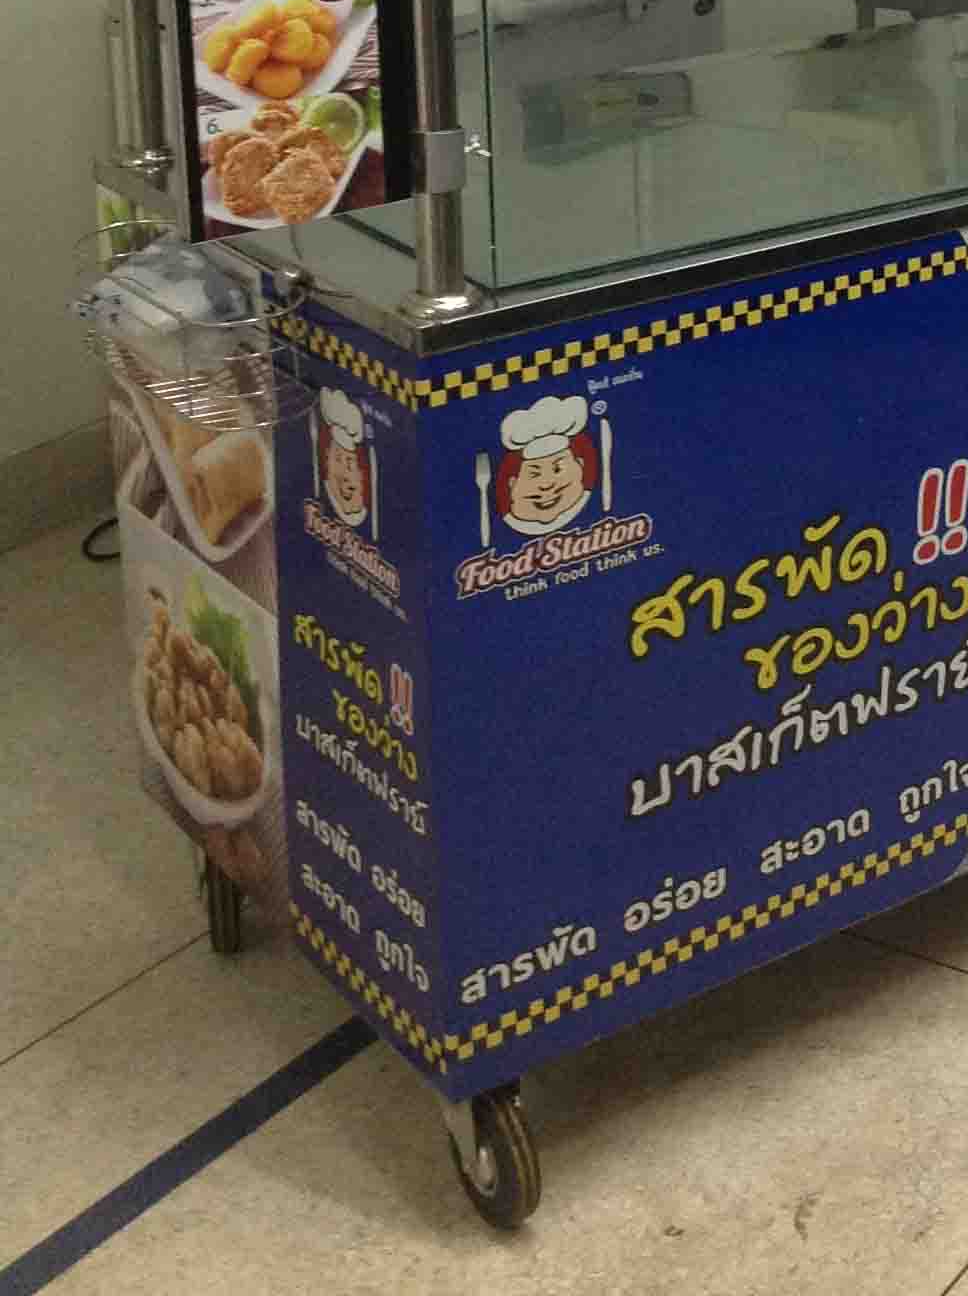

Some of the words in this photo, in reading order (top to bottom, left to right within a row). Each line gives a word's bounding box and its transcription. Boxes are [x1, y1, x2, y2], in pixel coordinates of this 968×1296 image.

[456, 536, 540, 599] Food
[538, 513, 653, 572] Station
[505, 578, 549, 600] think
[555, 564, 590, 586] food
[596, 551, 638, 573] think
[630, 514, 889, 658] สารพัด
[295, 613, 384, 705] สารพัด
[331, 687, 418, 783] ของว่าง
[296, 800, 363, 874] สารพัด
[371, 864, 426, 928] อร่อย
[460, 922, 598, 1005] สารพัด
[623, 865, 728, 932] อร่อย
[758, 807, 872, 876] สะอาด
